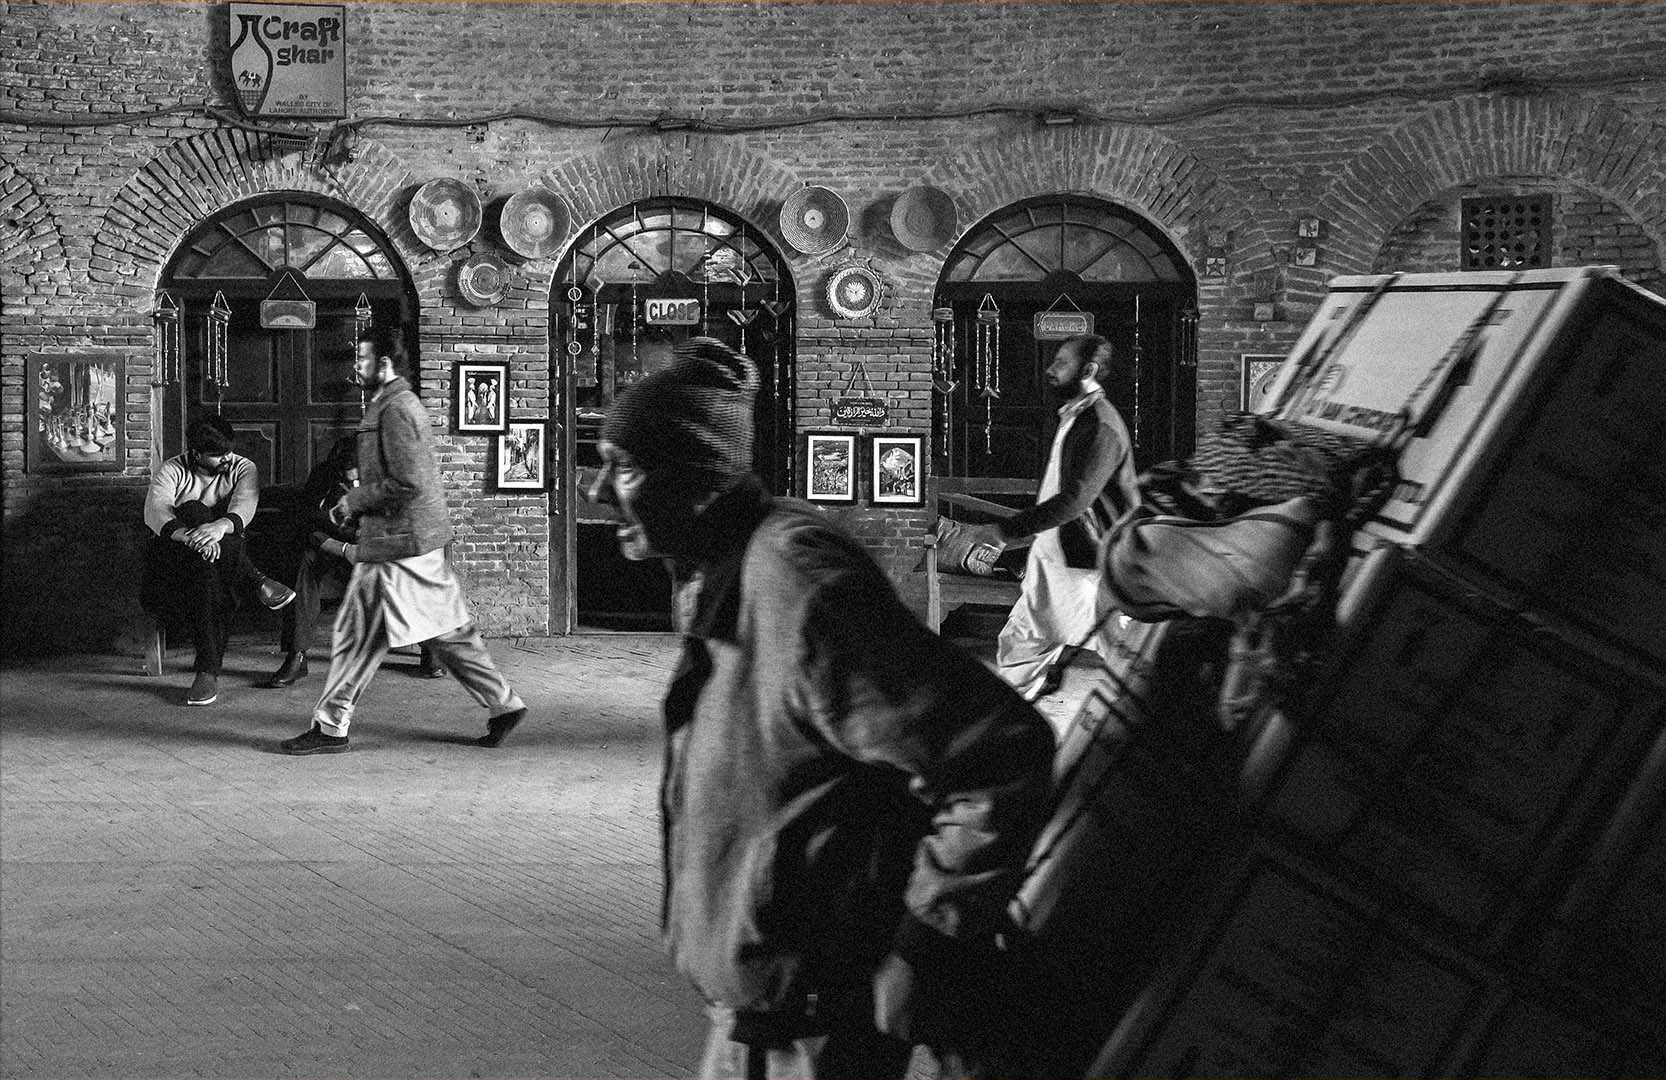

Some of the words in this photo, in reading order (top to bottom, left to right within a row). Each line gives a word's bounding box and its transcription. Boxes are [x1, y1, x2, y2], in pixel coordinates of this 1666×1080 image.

[263, 15, 340, 47] Craft
[277, 44, 334, 66] ghar
[649, 302, 699, 321] CLOSE
